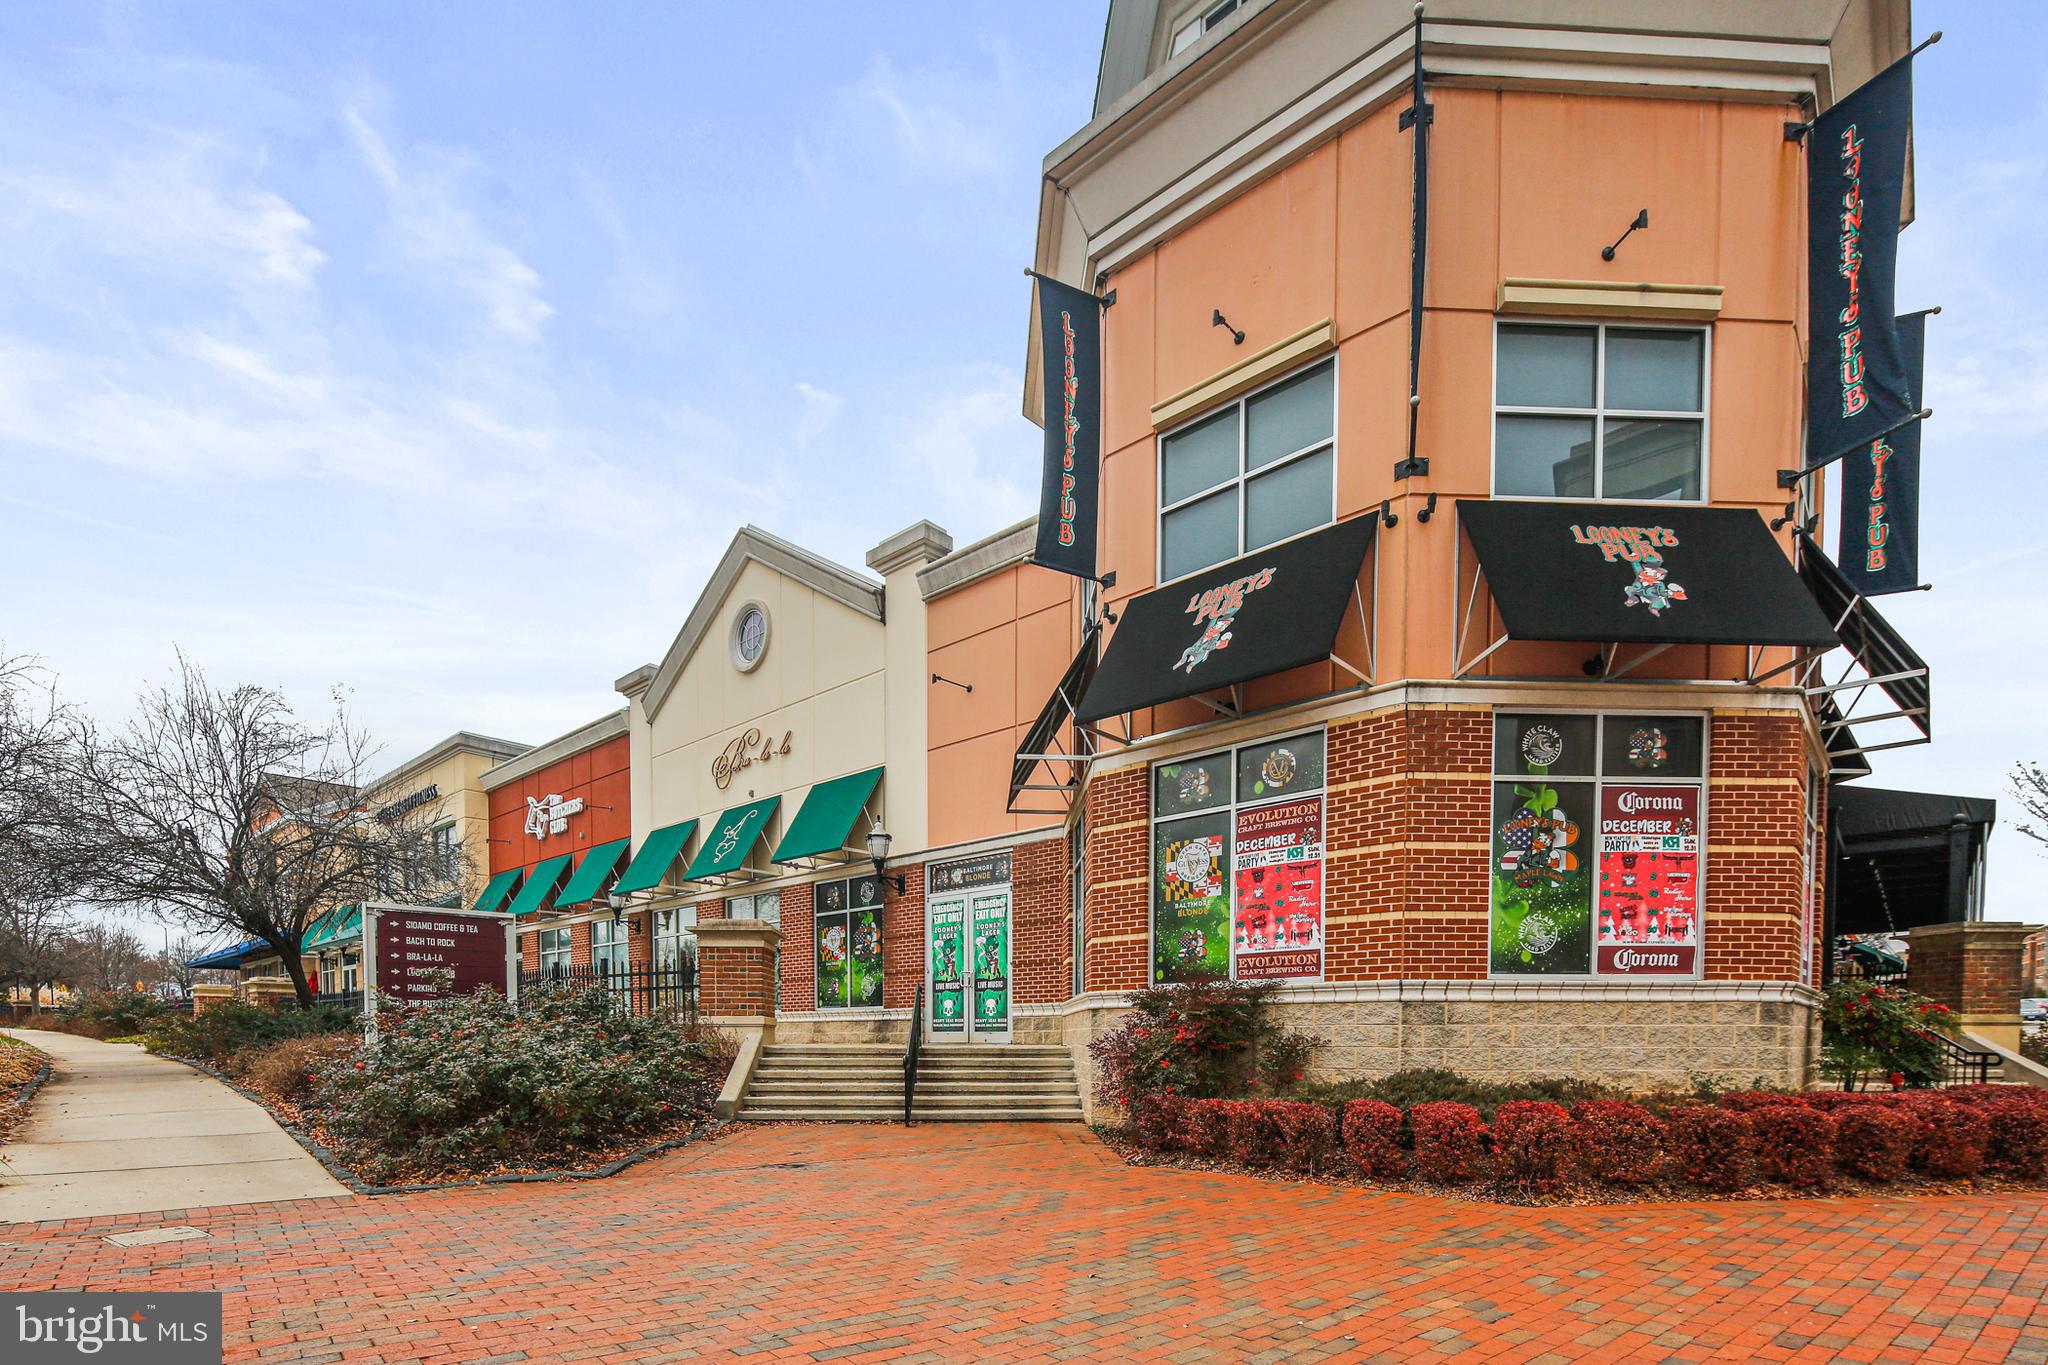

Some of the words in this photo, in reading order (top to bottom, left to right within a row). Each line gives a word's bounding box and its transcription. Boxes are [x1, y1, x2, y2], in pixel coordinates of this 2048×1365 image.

[1838, 327, 1868, 418] PUB
[1058, 473, 1076, 547] PUB
[1866, 503, 1889, 572] PUB
[1600, 543, 1663, 563] PUB
[1193, 595, 1243, 626] PUB
[1522, 727, 1537, 752] WHITE
[1537, 725, 1560, 739] CLAW
[1618, 792, 1683, 815] Corona
[1238, 802, 1320, 826] EVOLUTION
[1238, 823, 1264, 833] CRAFT
[1264, 817, 1303, 829] BREWING
[1305, 815, 1319, 823] CO.
[1552, 820, 1577, 834] PUB
[1602, 819, 1672, 833] DECEMBER
[1236, 833, 1297, 853] DECEMBER
[1605, 841, 1631, 851] PARTY
[964, 863, 993, 874] BALTIMORE
[1238, 856, 1260, 869] PARTY
[965, 872, 991, 881] BLONDE
[933, 902, 963, 914] EMERGENCY
[975, 897, 1006, 909] EMERGENCY
[1174, 900, 1211, 909] BALTIMORE
[934, 913, 947, 924] EXIT
[948, 911, 963, 923] ONLY
[976, 909, 989, 920] EXIT
[990, 907, 1006, 918] ONLY
[1177, 908, 1209, 917] BLONDE
[405, 921, 432, 930] SIDAMO
[433, 922, 458, 932] COFFEE
[459, 924, 465, 932] &
[466, 924, 478, 933] TEA
[1519, 915, 1533, 939] WHITE
[1533, 913, 1555, 926] CLAW
[939, 932, 957, 940] LAGER
[981, 929, 1000, 937] LAGER
[405, 937, 425, 946] BACH
[426, 938, 436, 946] TO
[437, 938, 456, 947] ROCK
[406, 952, 443, 962] BRA-LA-LA
[1238, 954, 1318, 968] EVOLUTION
[1613, 949, 1679, 971] Corona
[1239, 968, 1264, 976] CRAFT
[1266, 965, 1303, 974] BREWING
[935, 982, 945, 990] LIVE
[945, 981, 960, 990] MUSIC
[977, 981, 987, 989] LIVE
[987, 980, 1003, 989] MUSIC
